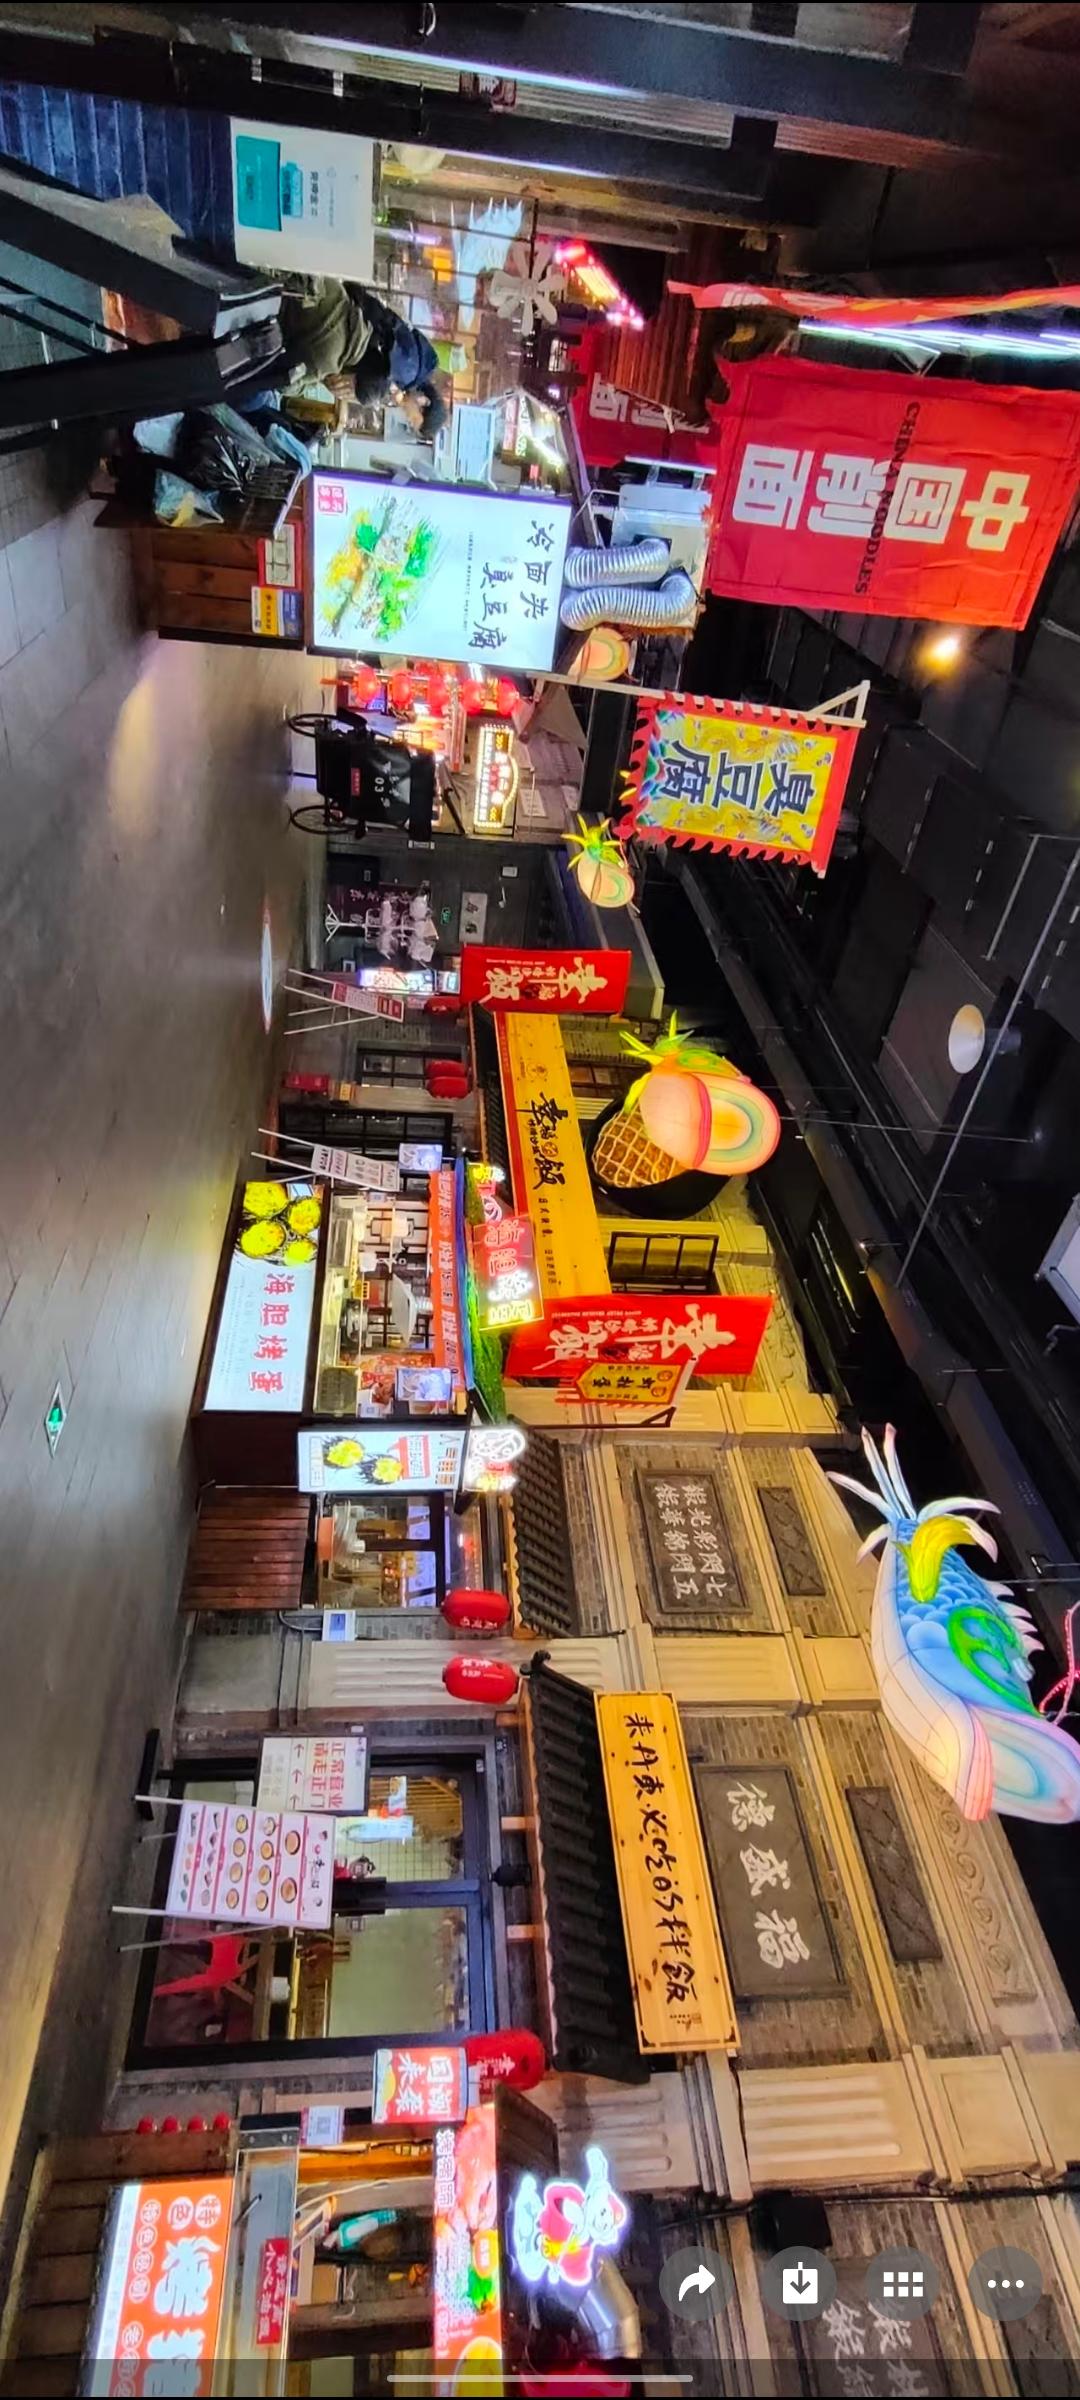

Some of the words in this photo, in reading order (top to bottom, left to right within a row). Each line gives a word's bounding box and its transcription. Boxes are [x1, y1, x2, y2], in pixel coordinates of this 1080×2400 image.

[885, 402, 921, 478] CHINA
[732, 444, 1030, 551] 中国削面
[520, 519, 555, 620] 冷面夹
[854, 490, 894, 594] NOODLES
[467, 562, 513, 650] 臭豆腐
[374, 777, 385, 793] 03
[658, 740, 815, 818] 臭豆腐
[249, 1273, 296, 1394] 海胆烤蛋
[310, 1743, 328, 1809] 请走正门
[328, 1743, 346, 1809] 正常营业
